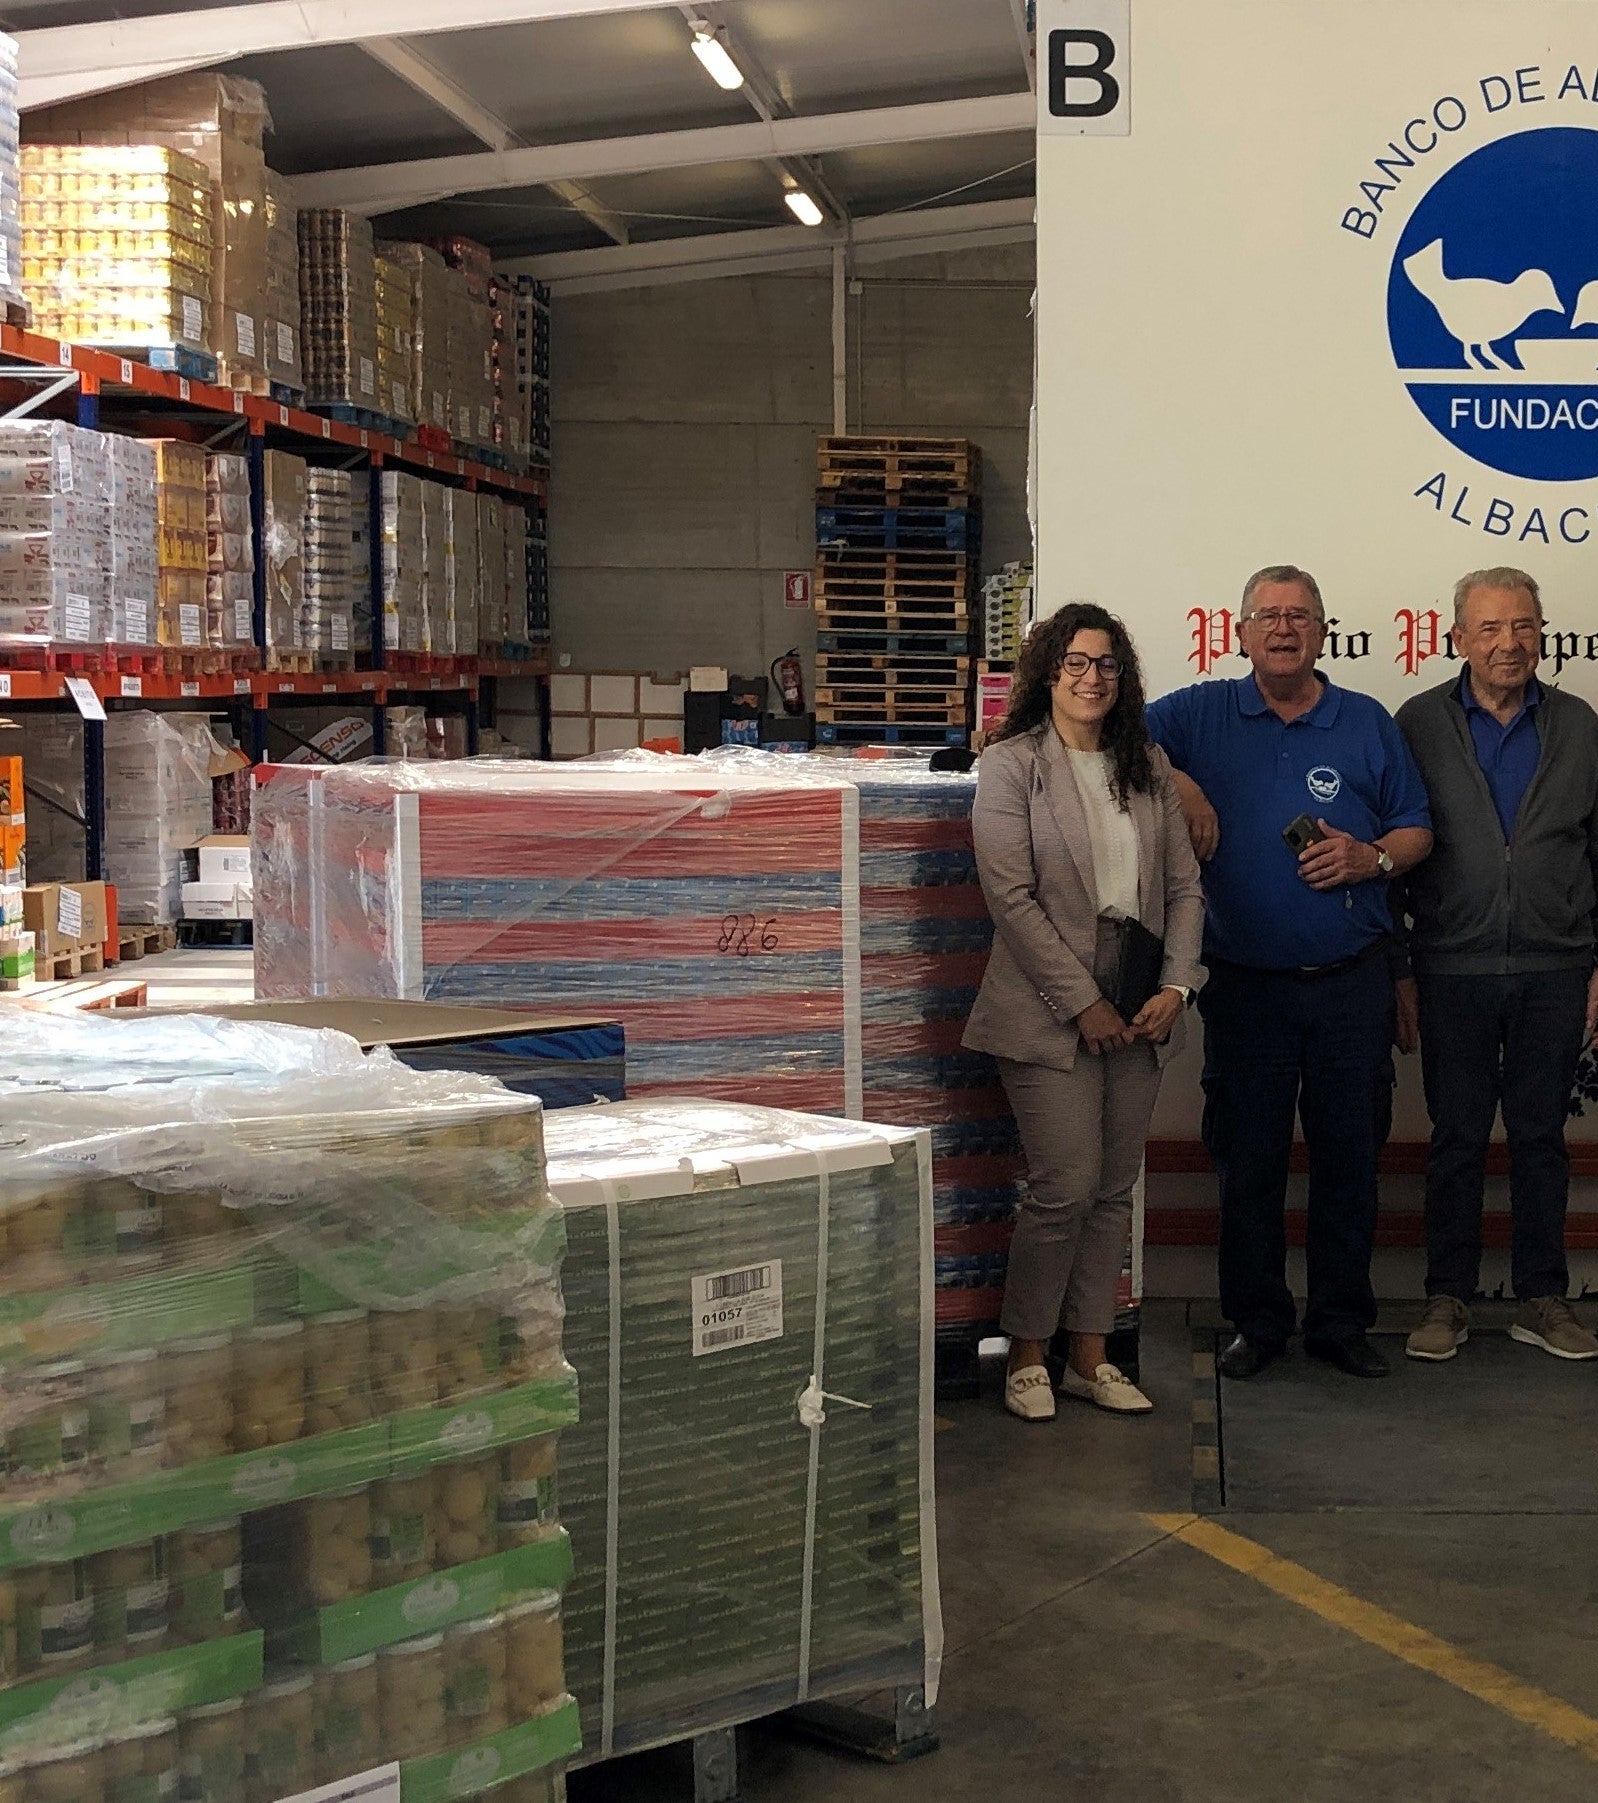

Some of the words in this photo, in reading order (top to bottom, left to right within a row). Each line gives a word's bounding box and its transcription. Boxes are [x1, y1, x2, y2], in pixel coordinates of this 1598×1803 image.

[1049, 29, 1121, 117] B
[1340, 96, 1467, 240] BANCO
[1478, 65, 1546, 113] DE
[1186, 607, 1372, 677] Pio
[717, 913, 779, 957] 886
[701, 1307, 743, 1327] 01057
